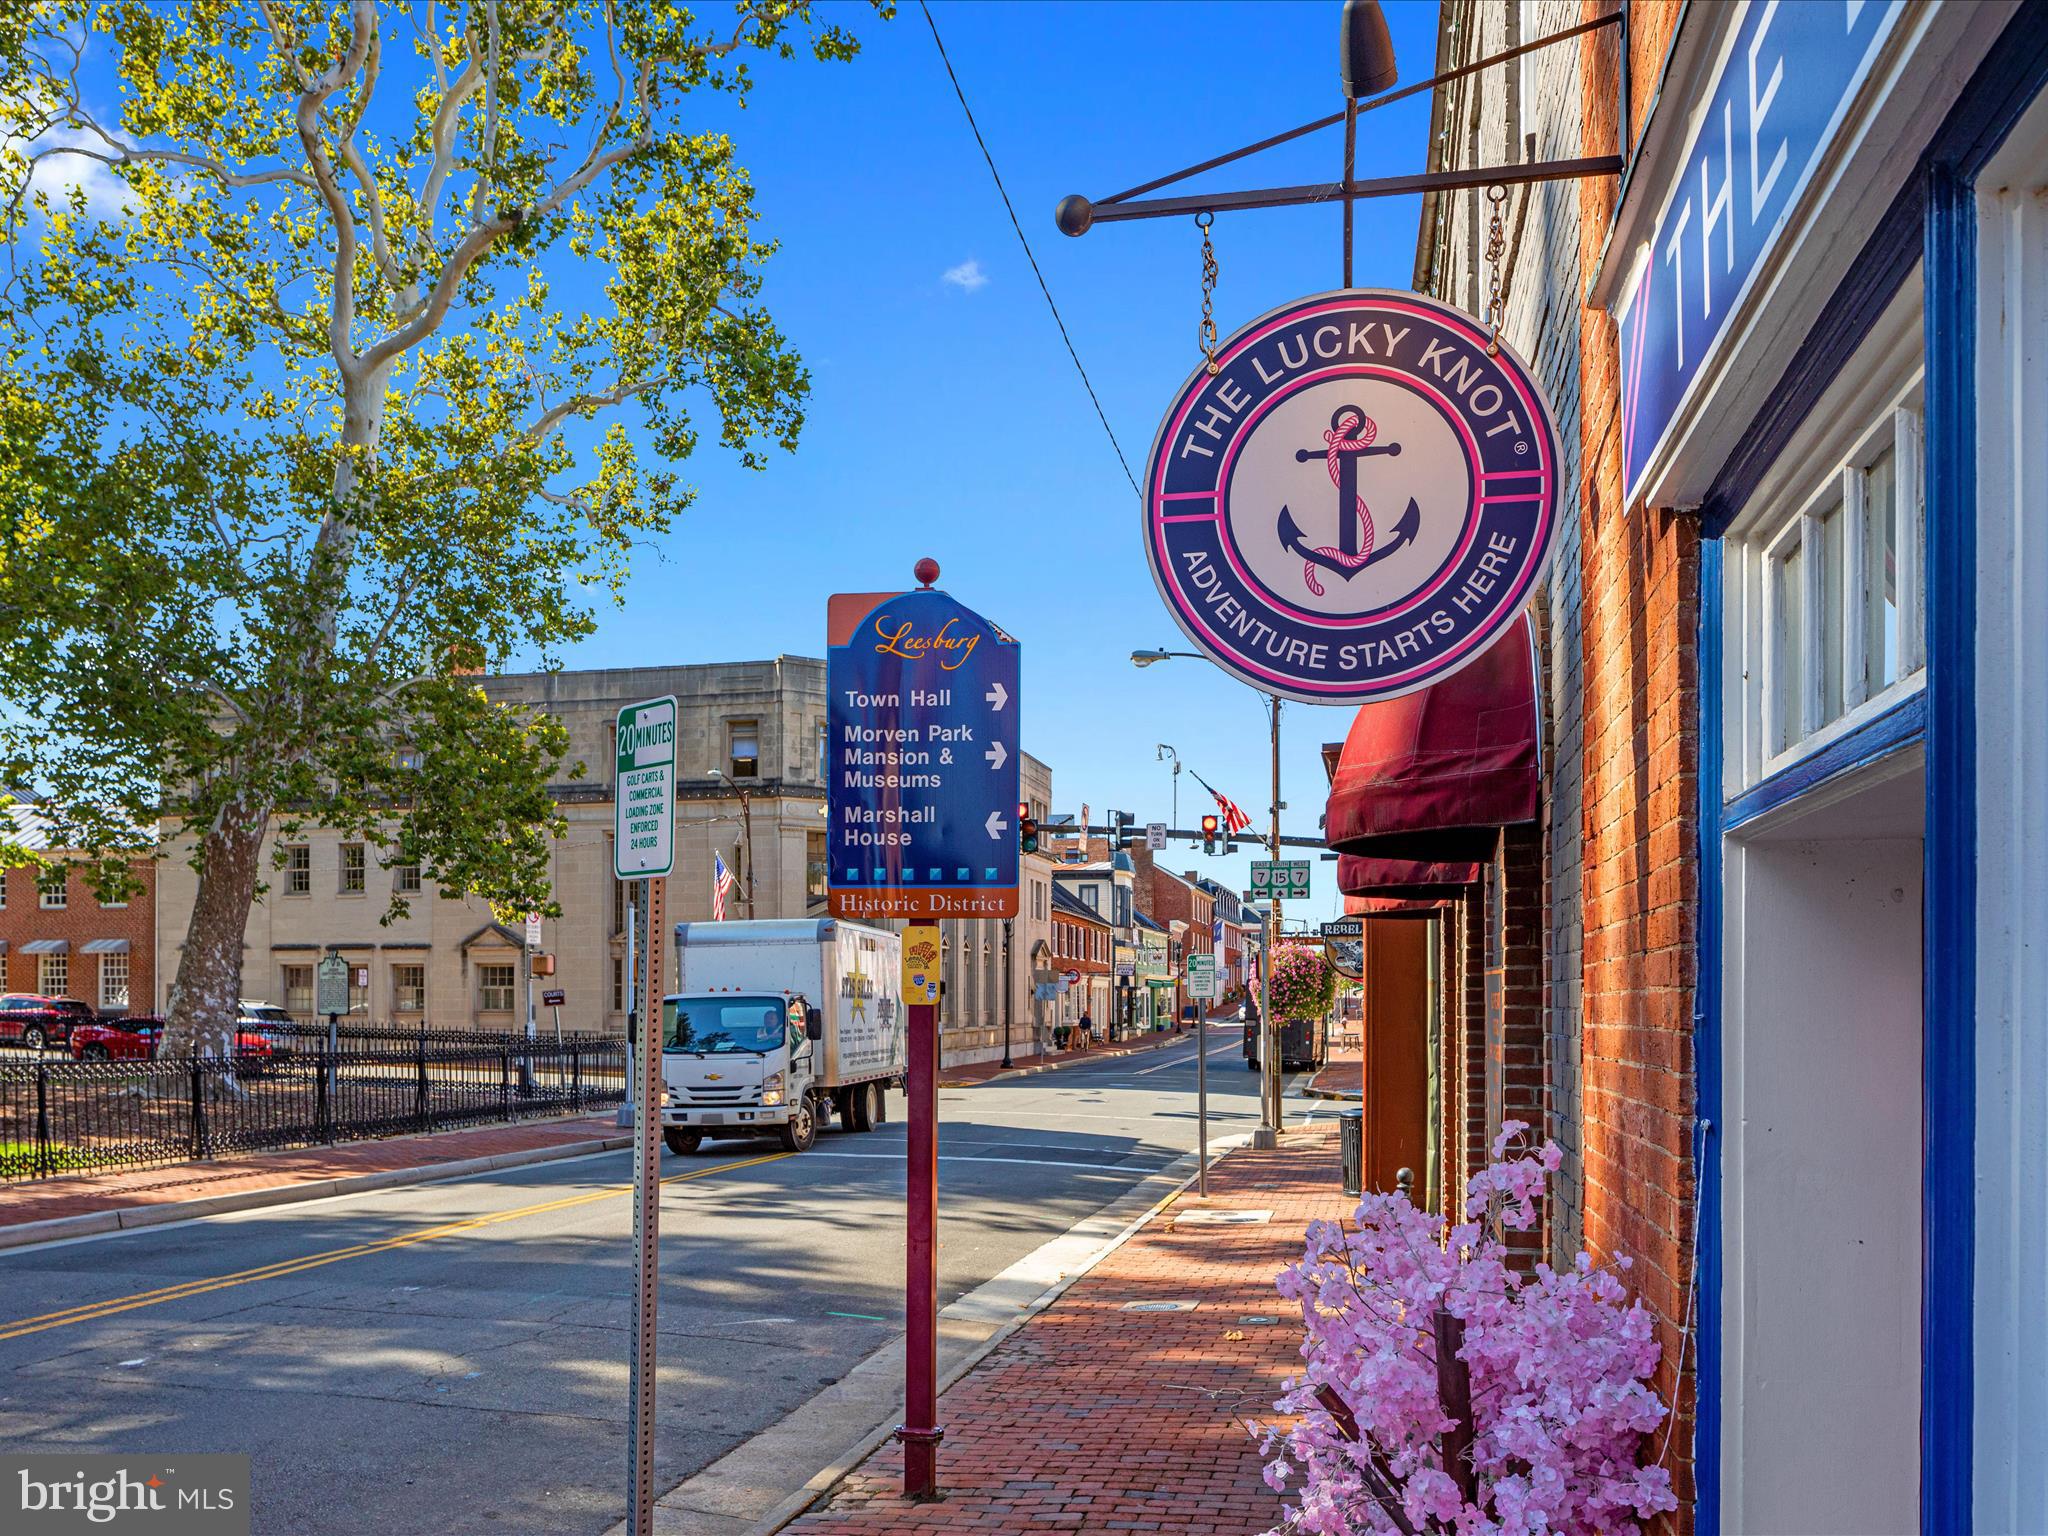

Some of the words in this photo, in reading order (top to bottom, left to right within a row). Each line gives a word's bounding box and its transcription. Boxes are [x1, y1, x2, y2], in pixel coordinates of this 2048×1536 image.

[1666, 0, 1788, 372] THE
[1181, 378, 1252, 461] THE
[1252, 322, 1411, 386] LUCKY
[1417, 337, 1522, 440] KNOT
[1182, 550, 1329, 670] ADVENTURE
[1338, 609, 1455, 671] STARTS
[1452, 531, 1517, 615] HERE
[875, 615, 980, 670] Leesburg
[845, 690, 899, 707] Town
[911, 690, 951, 706] Hall
[619, 724, 635, 756] 20
[635, 721, 673, 749] MINUTES
[844, 726, 919, 742] Morven
[929, 724, 974, 742] Park
[844, 748, 929, 765] Mansion
[939, 748, 953, 765] &
[627, 773, 640, 787] GOLF
[641, 771, 659, 784] CARTS
[658, 770, 665, 781] &
[844, 771, 941, 788] Museums
[629, 787, 664, 802] COMMERCIAL
[625, 805, 649, 819] LOADING
[649, 803, 664, 816] ZONE
[845, 806, 935, 823] Marshall
[630, 820, 659, 834] ENFORCED
[630, 838, 638, 850] 24
[638, 836, 658, 849] HOURS
[845, 830, 912, 846] House
[1258, 872, 1265, 883] 7
[1275, 872, 1286, 884] 15
[1296, 872, 1303, 882] 7
[840, 894, 919, 912] Historic
[929, 894, 1005, 911] District
[1324, 924, 1362, 935] REBEL
[1189, 959, 1196, 967] 20
